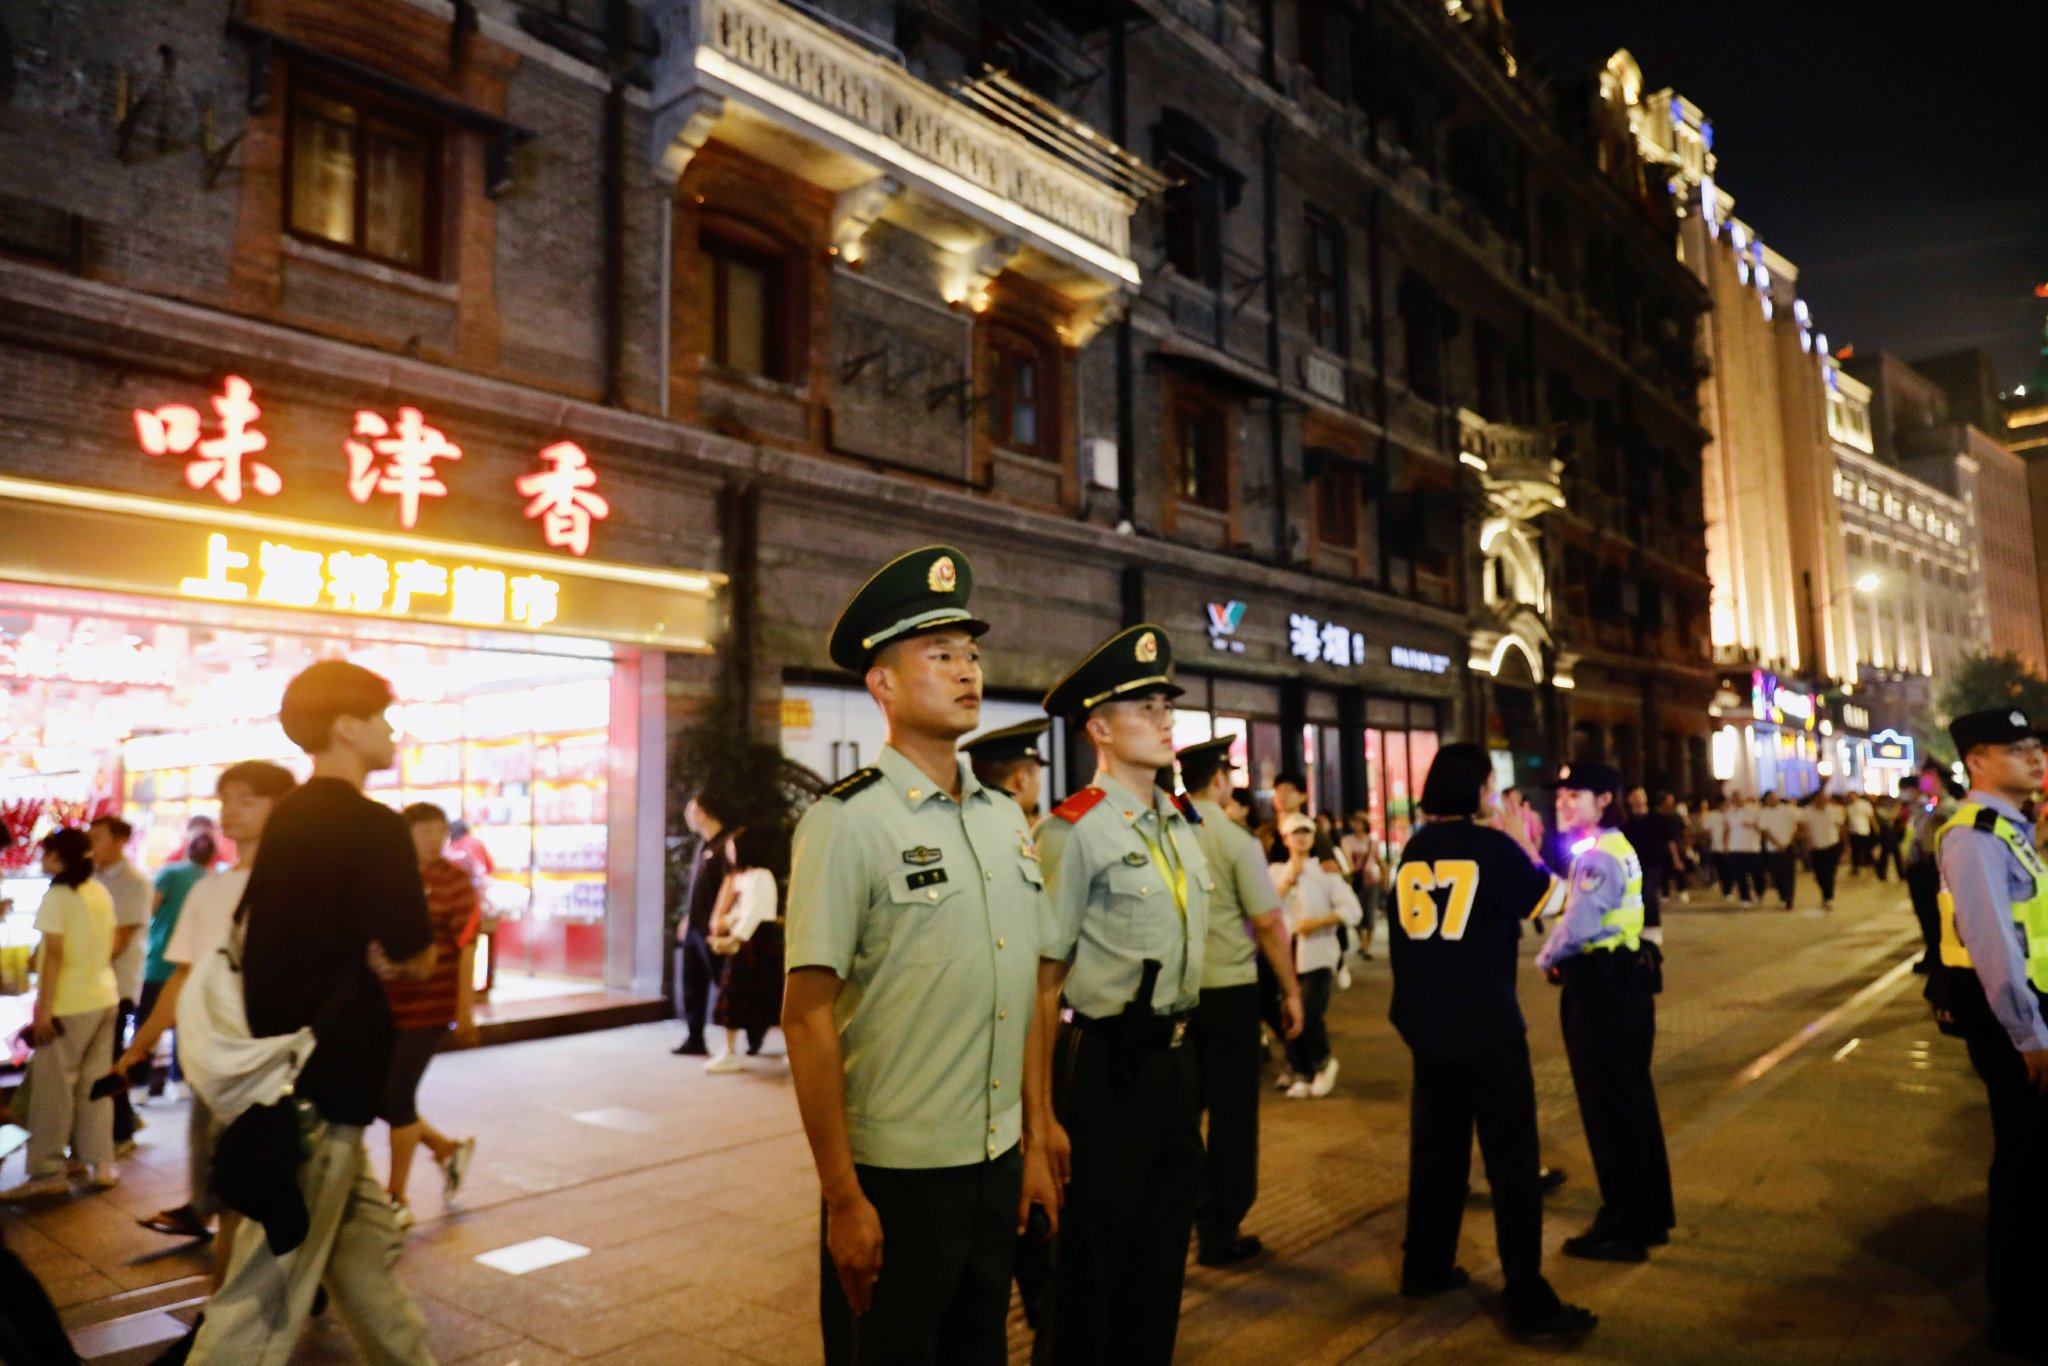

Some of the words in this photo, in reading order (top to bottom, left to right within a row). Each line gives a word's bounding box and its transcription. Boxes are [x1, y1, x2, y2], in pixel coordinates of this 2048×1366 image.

[133, 375, 609, 556] 味津香
[179, 532, 560, 628] 上海特产超市
[1396, 859, 1480, 940] 67
